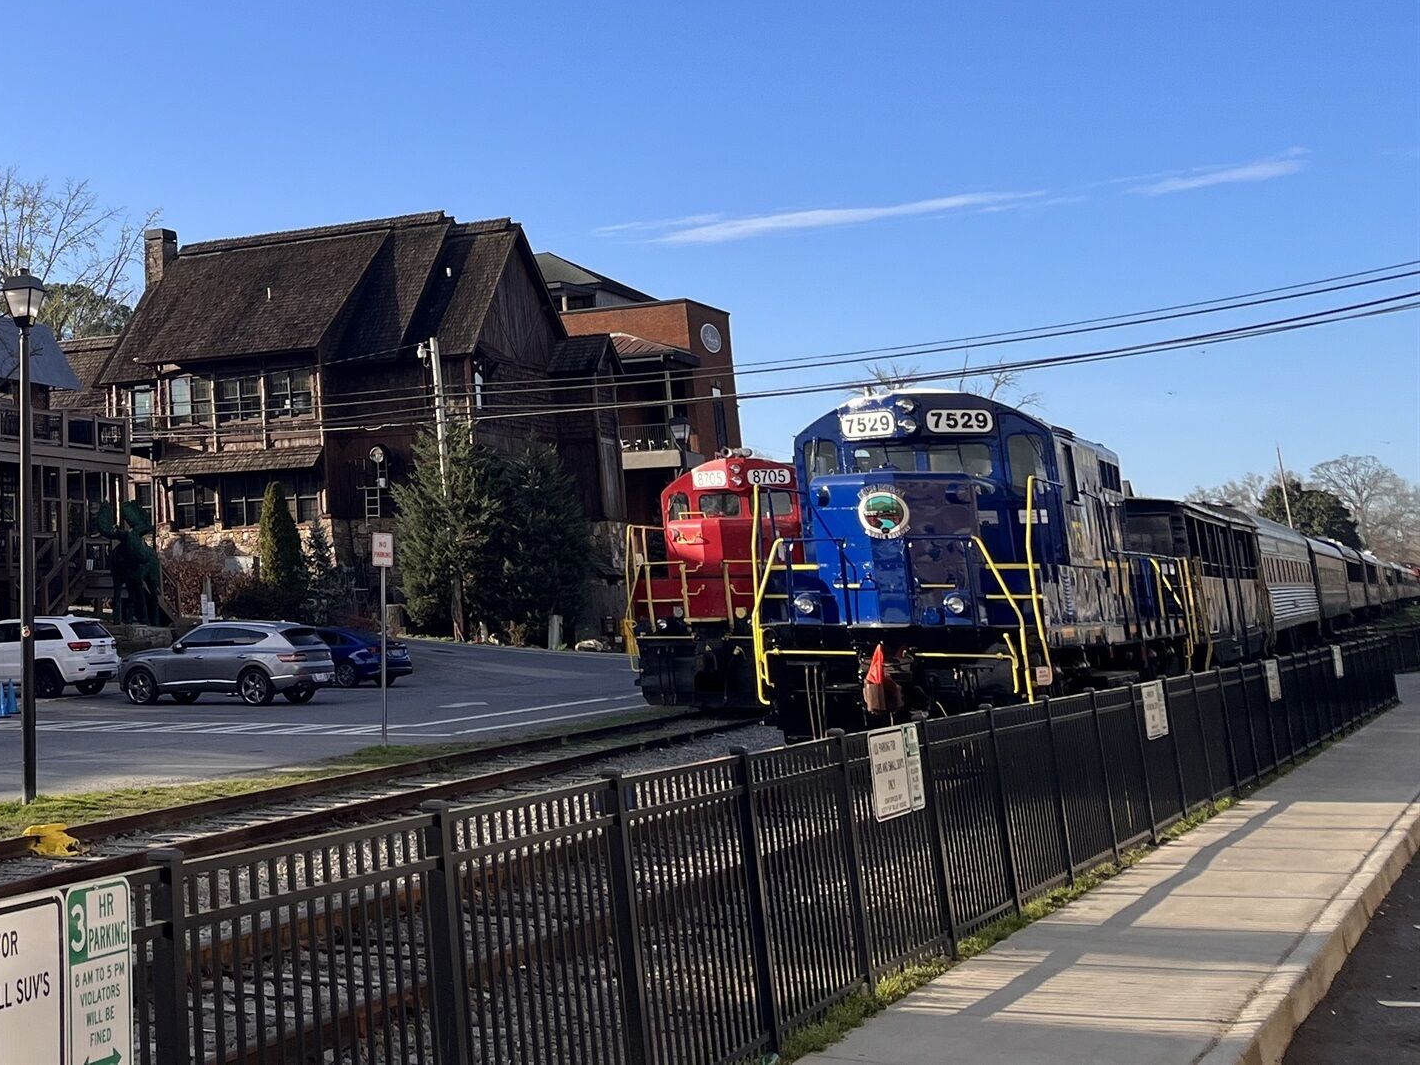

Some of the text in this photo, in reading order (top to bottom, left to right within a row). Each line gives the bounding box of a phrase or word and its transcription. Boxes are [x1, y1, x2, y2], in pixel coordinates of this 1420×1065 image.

[845, 415, 890, 434] 7529
[930, 412, 988, 429] 7529
[697, 472, 723, 486] 8705
[753, 470, 786, 484] 8705
[70, 892, 114, 953] 3 HR
[88, 920, 127, 953] PARKING
[74, 961, 125, 988] 8 AM TO 5 PM
[16, 971, 50, 1004] SUV'S
[80, 983, 121, 1008] VIOLATORS
[86, 1005, 115, 1028] WILL BE
[89, 1027, 111, 1048] FINED
